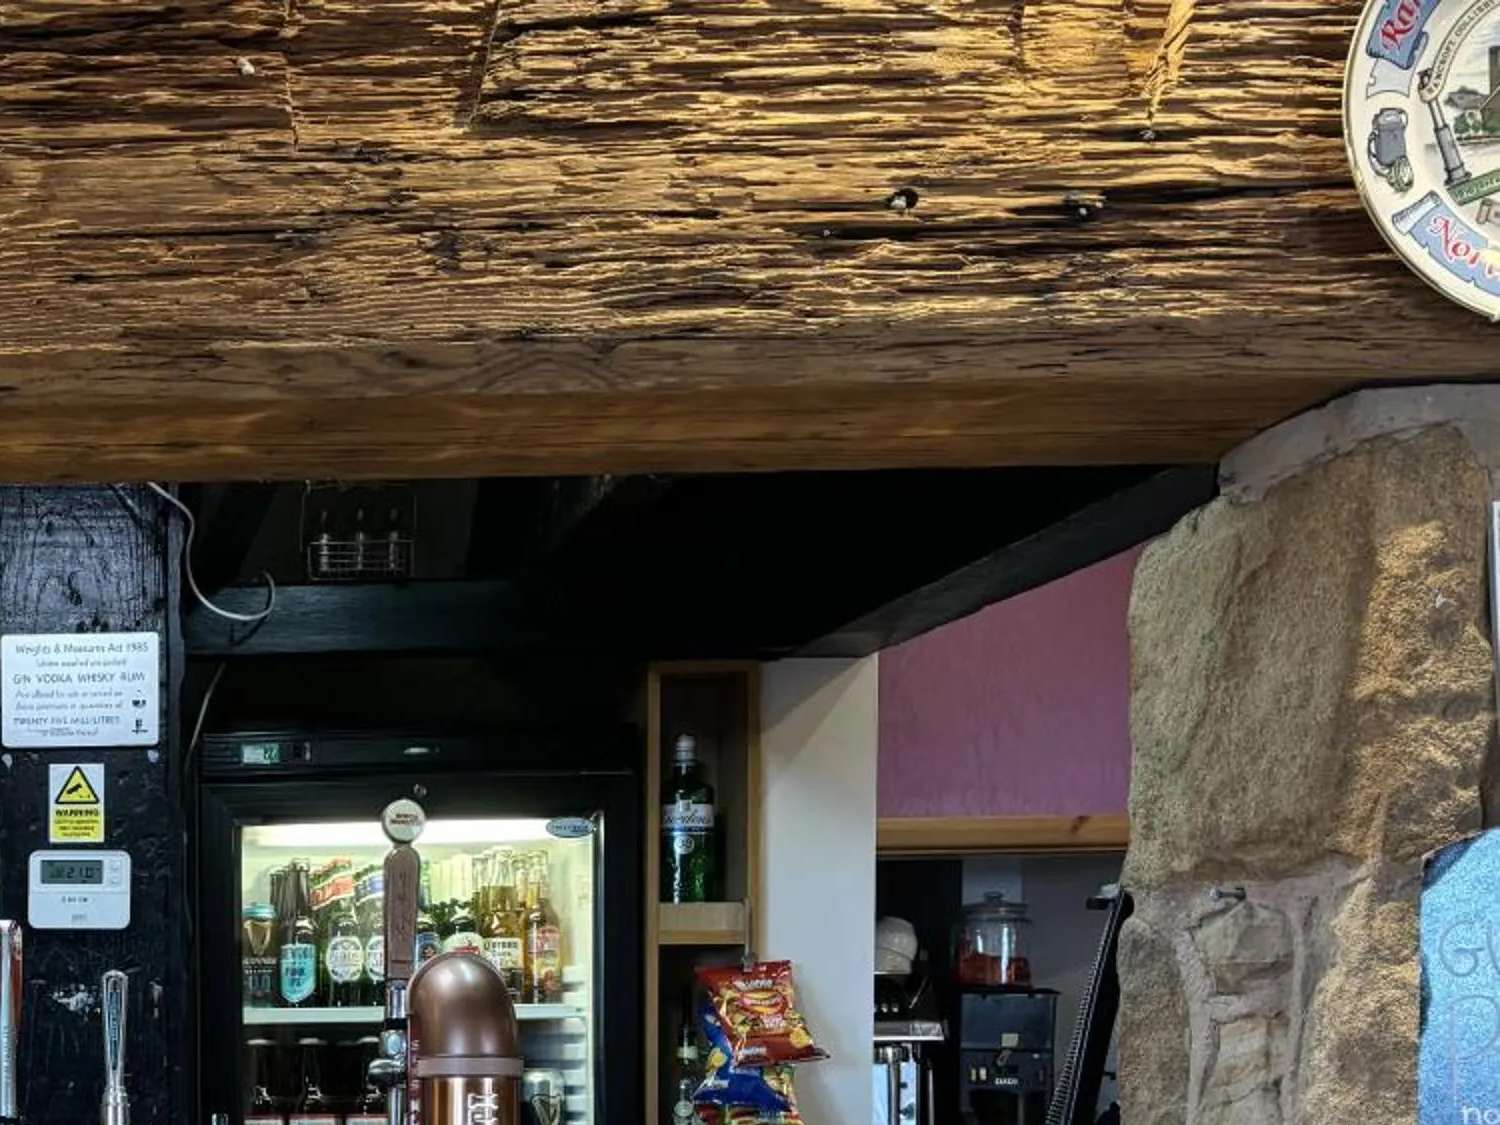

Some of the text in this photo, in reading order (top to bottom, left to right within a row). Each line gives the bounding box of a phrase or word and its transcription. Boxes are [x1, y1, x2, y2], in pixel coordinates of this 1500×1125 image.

[13, 672, 145, 684] GIN VODKA WHISKY RUM
